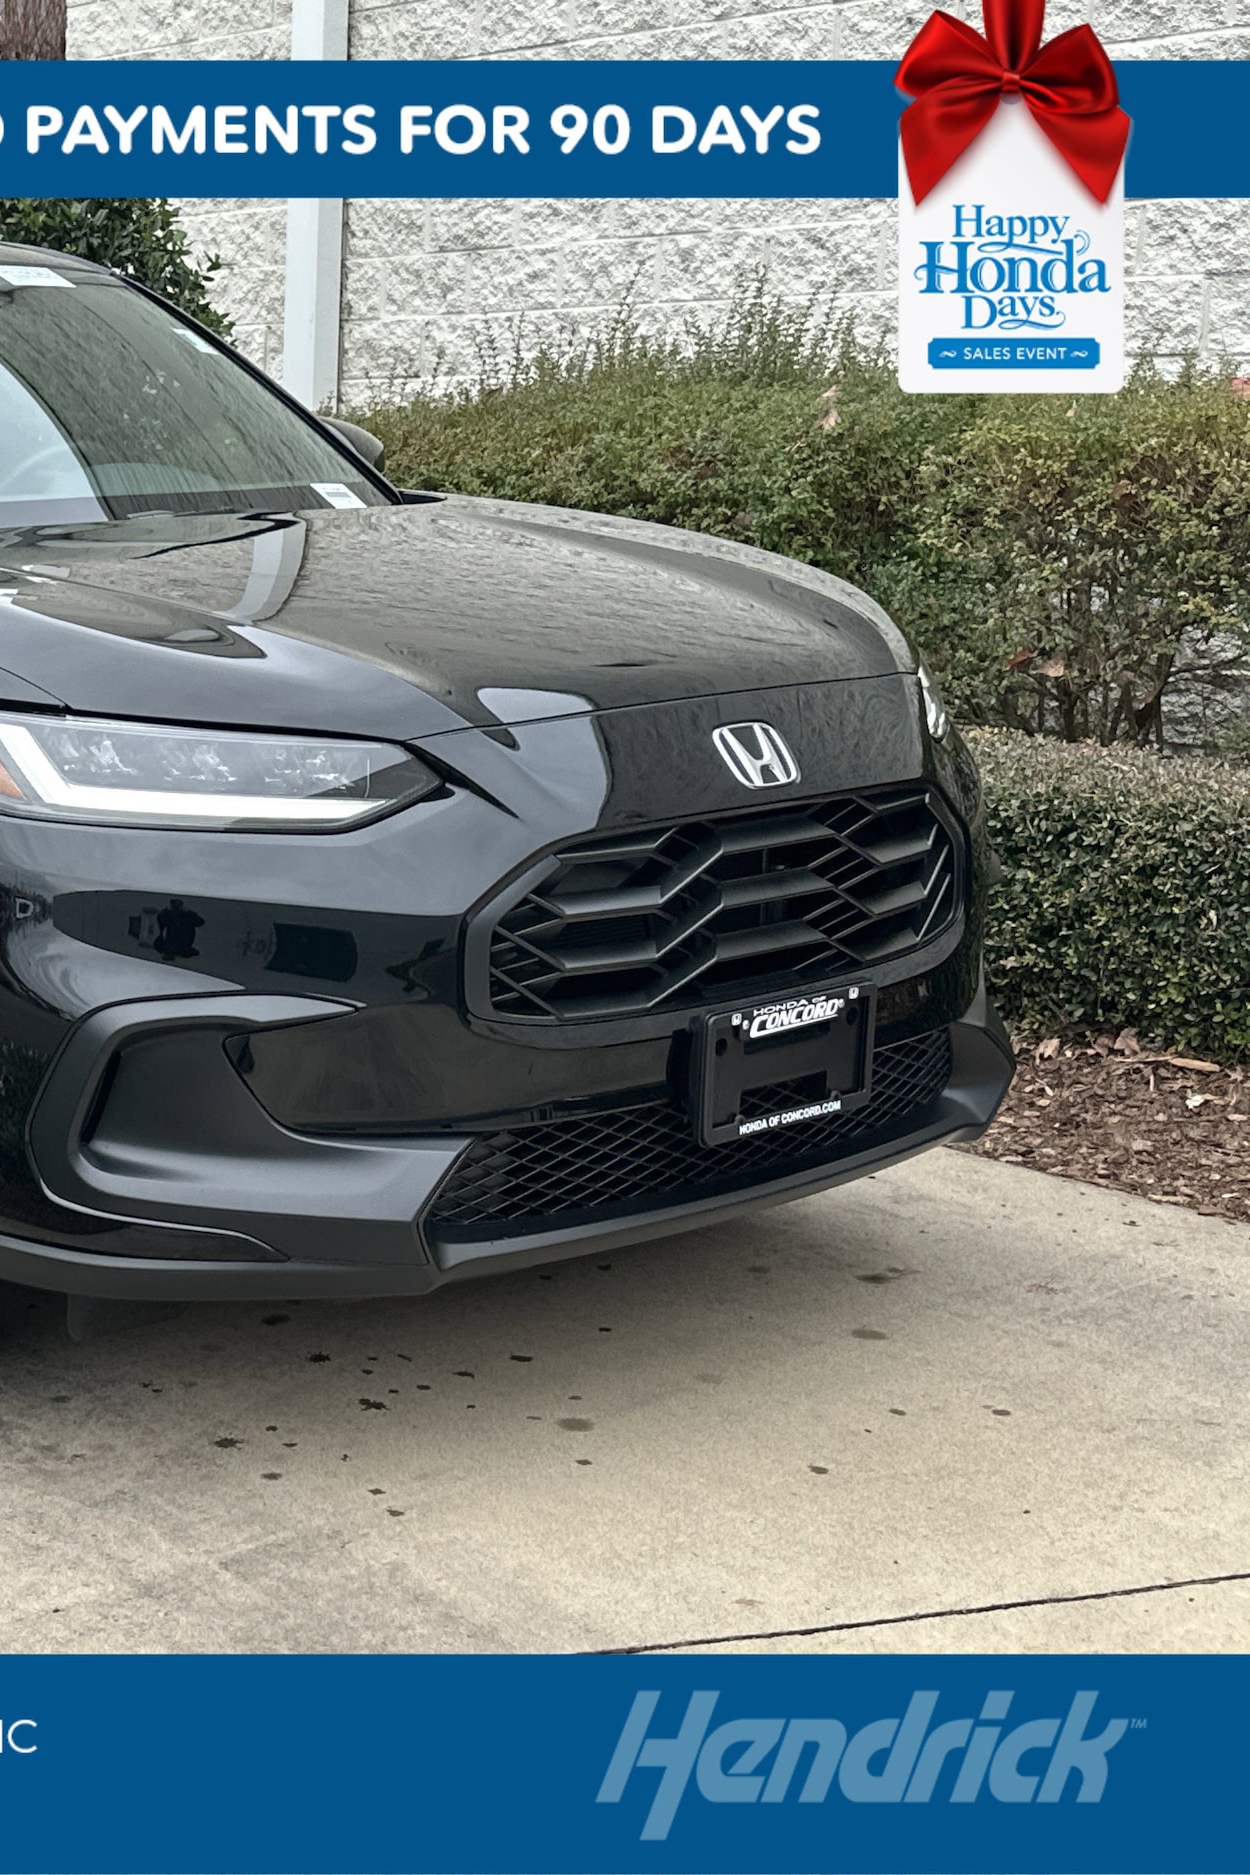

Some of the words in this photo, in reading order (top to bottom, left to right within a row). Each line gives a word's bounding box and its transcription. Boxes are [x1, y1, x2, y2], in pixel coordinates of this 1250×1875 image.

[750, 998, 839, 1038] CONCORD
[753, 999, 809, 1016] HONDA
[739, 1119, 768, 1135] HONDA
[769, 1115, 781, 1127] OF
[781, 1100, 842, 1124] CONCORD.COM
